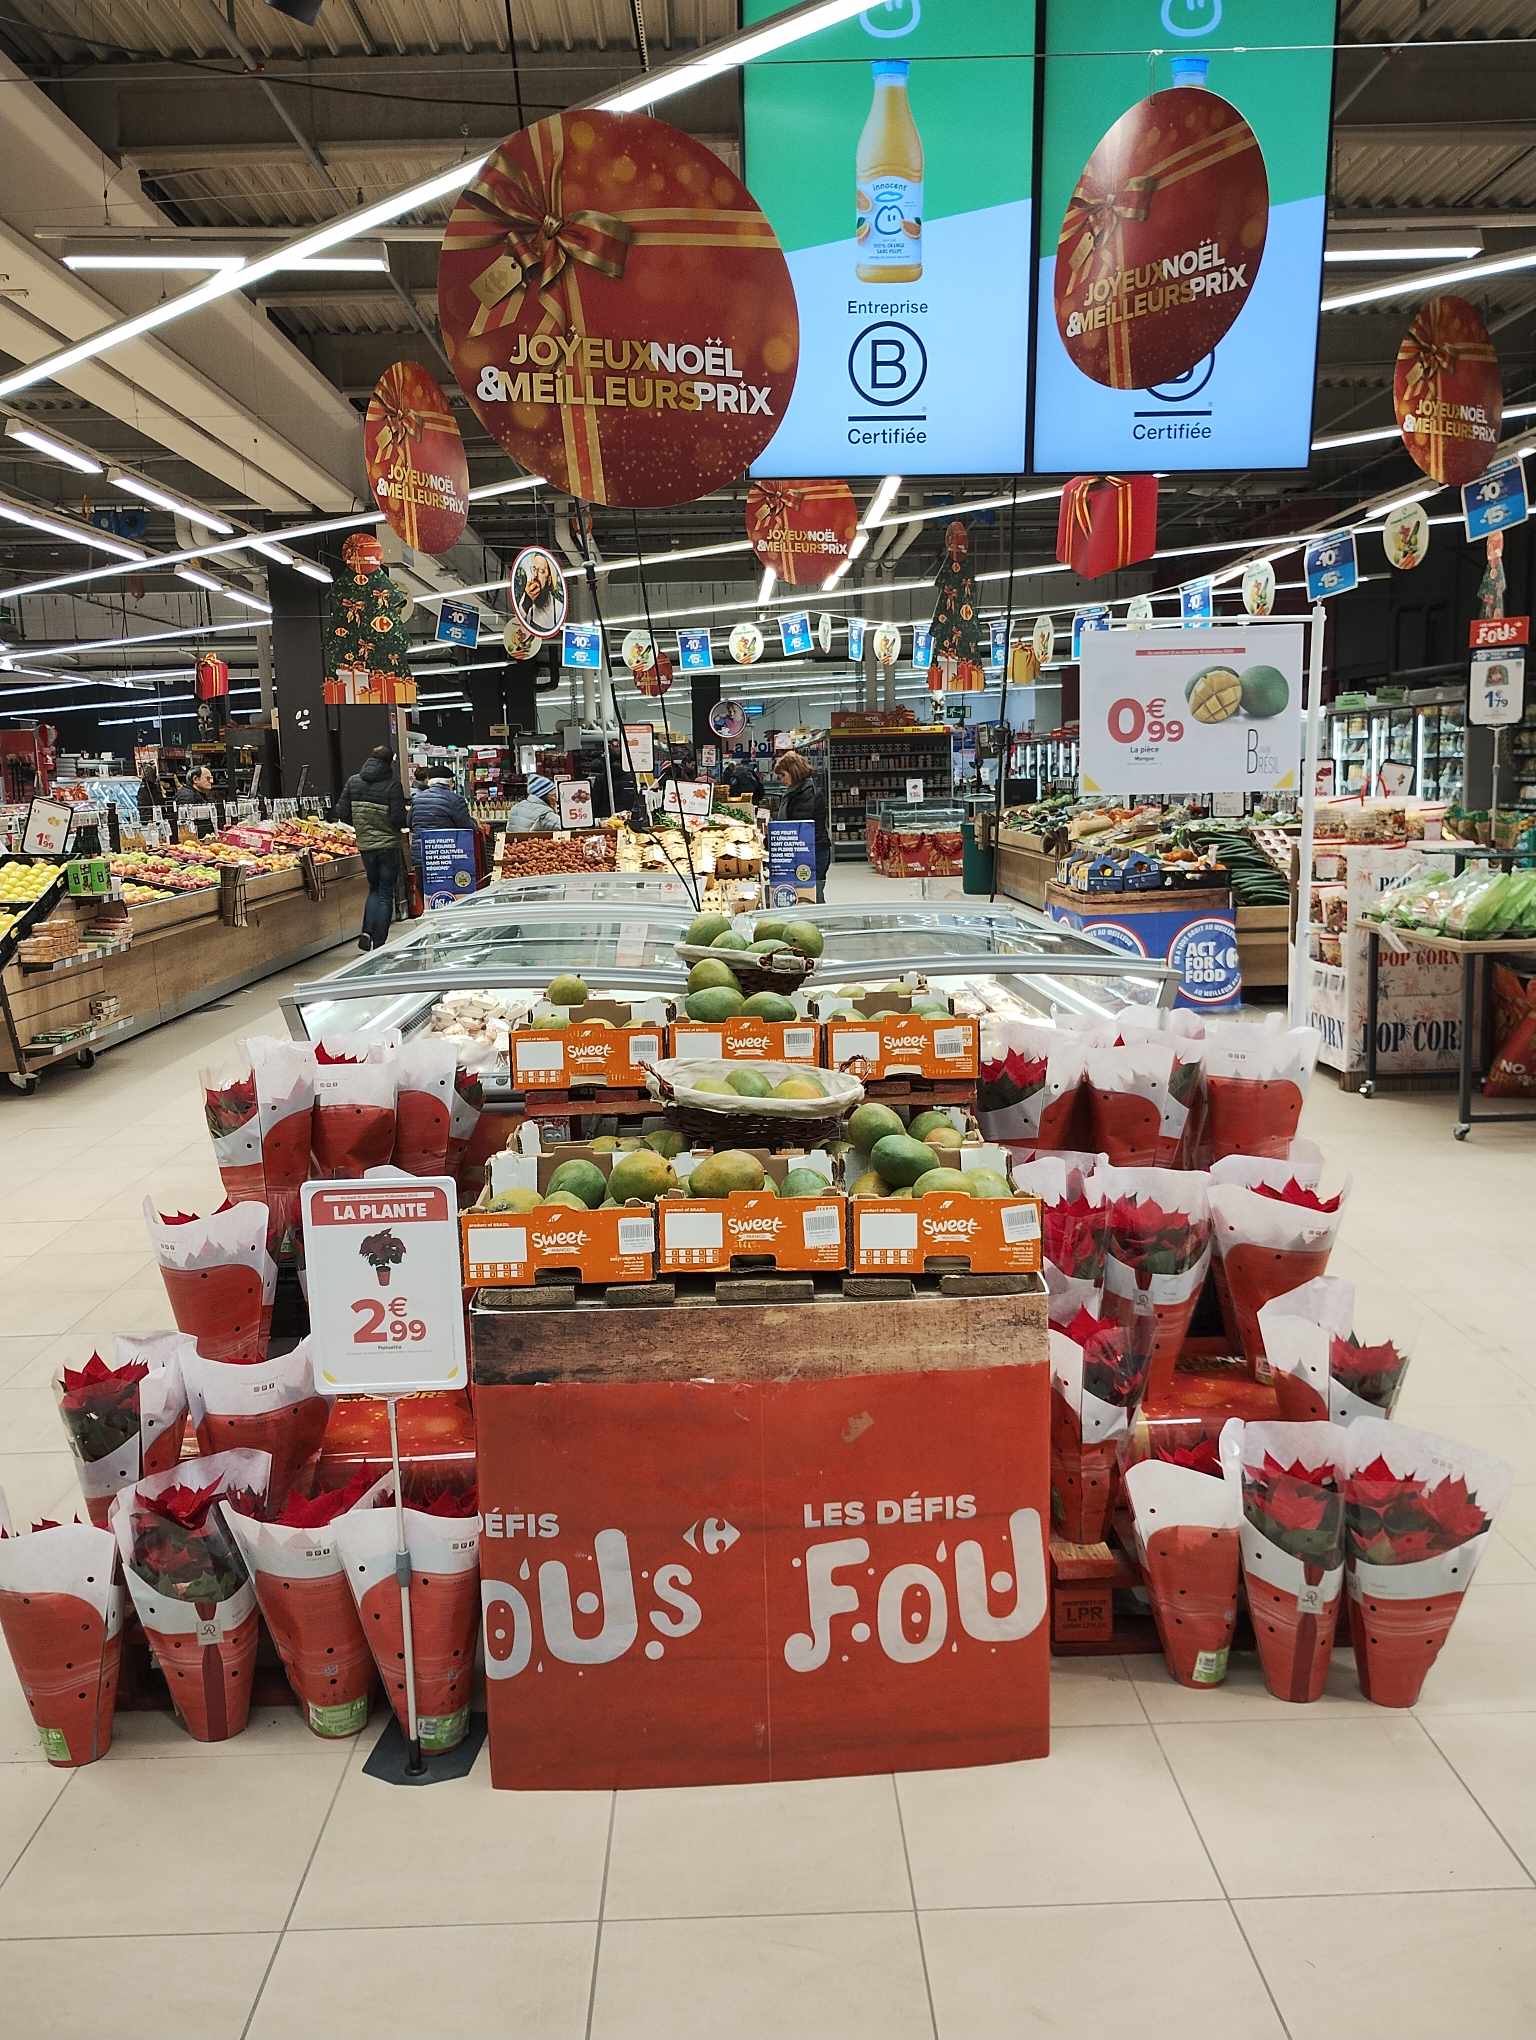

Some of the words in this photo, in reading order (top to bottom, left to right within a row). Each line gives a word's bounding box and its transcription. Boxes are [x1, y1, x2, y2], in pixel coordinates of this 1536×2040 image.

[872, 183, 907, 192] innocent
[1083, 265, 1164, 307] JOYEUX
[1161, 238, 1225, 281] NOËL
[847, 299, 928, 318] Entreprise
[510, 333, 657, 371] JOYEUX
[651, 336, 743, 379] NOËL
[870, 339, 907, 389] B
[847, 428, 927, 445] Certifiée
[1132, 423, 1213, 441] Certifiée
[1186, 941, 1217, 957] ACT
[1185, 956, 1214, 971] FOR
[1378, 952, 1411, 967] POP
[1416, 950, 1460, 966] CORN
[1185, 968, 1226, 983] FOOD
[567, 1044, 613, 1058] Sweet
[726, 1035, 772, 1050] Sweet
[884, 1034, 930, 1050] Sweet
[333, 1205, 355, 1221] LA
[359, 1202, 428, 1220] PLANTE
[728, 1216, 785, 1234] Sweet
[922, 1218, 980, 1236] Sweet
[532, 1230, 591, 1248] Sweet
[803, 1501, 866, 1529] LES
[876, 1491, 978, 1526] DÉFIS
[479, 1507, 560, 1538] ÉFIS
[1066, 1606, 1104, 1622] LPR
